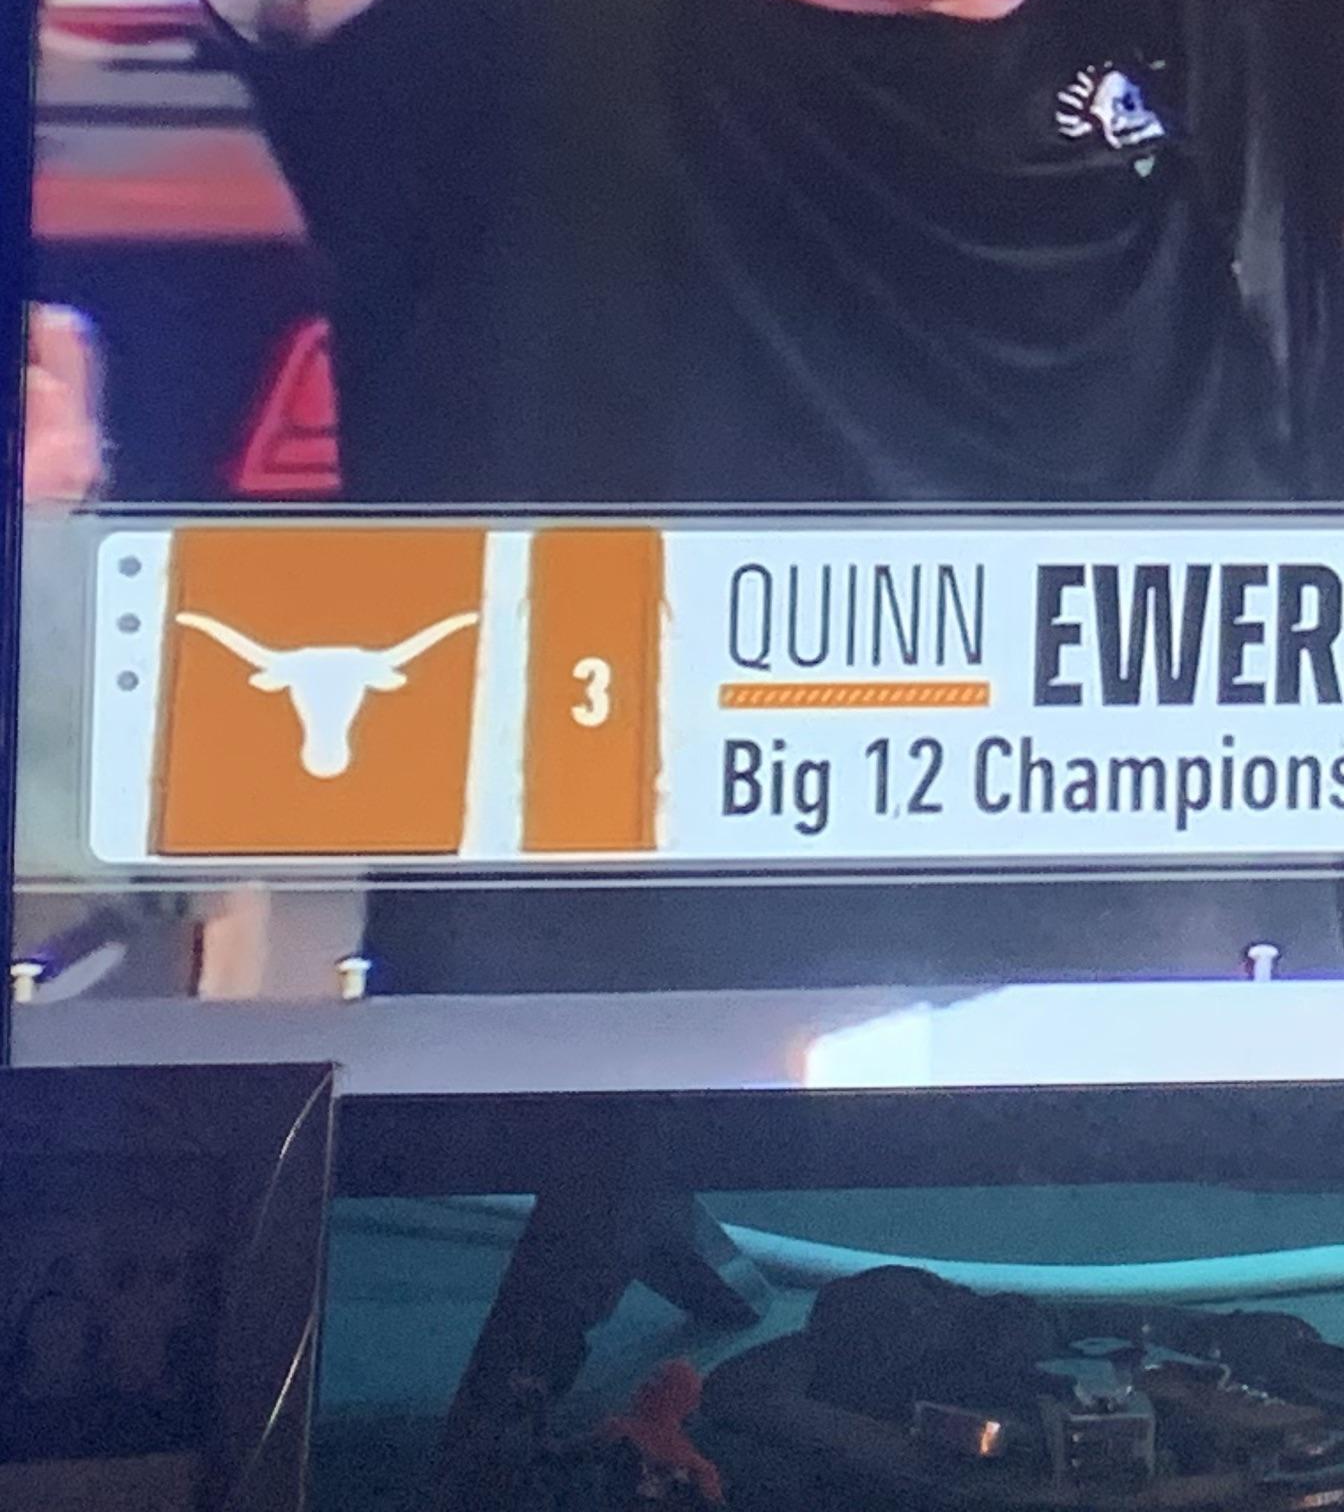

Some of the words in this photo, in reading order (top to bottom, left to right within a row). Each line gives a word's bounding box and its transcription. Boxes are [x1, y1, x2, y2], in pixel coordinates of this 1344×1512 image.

[728, 562, 985, 671] QUINN
[570, 658, 612, 728] 3
[721, 738, 831, 835] Big
[863, 737, 944, 815] 12
